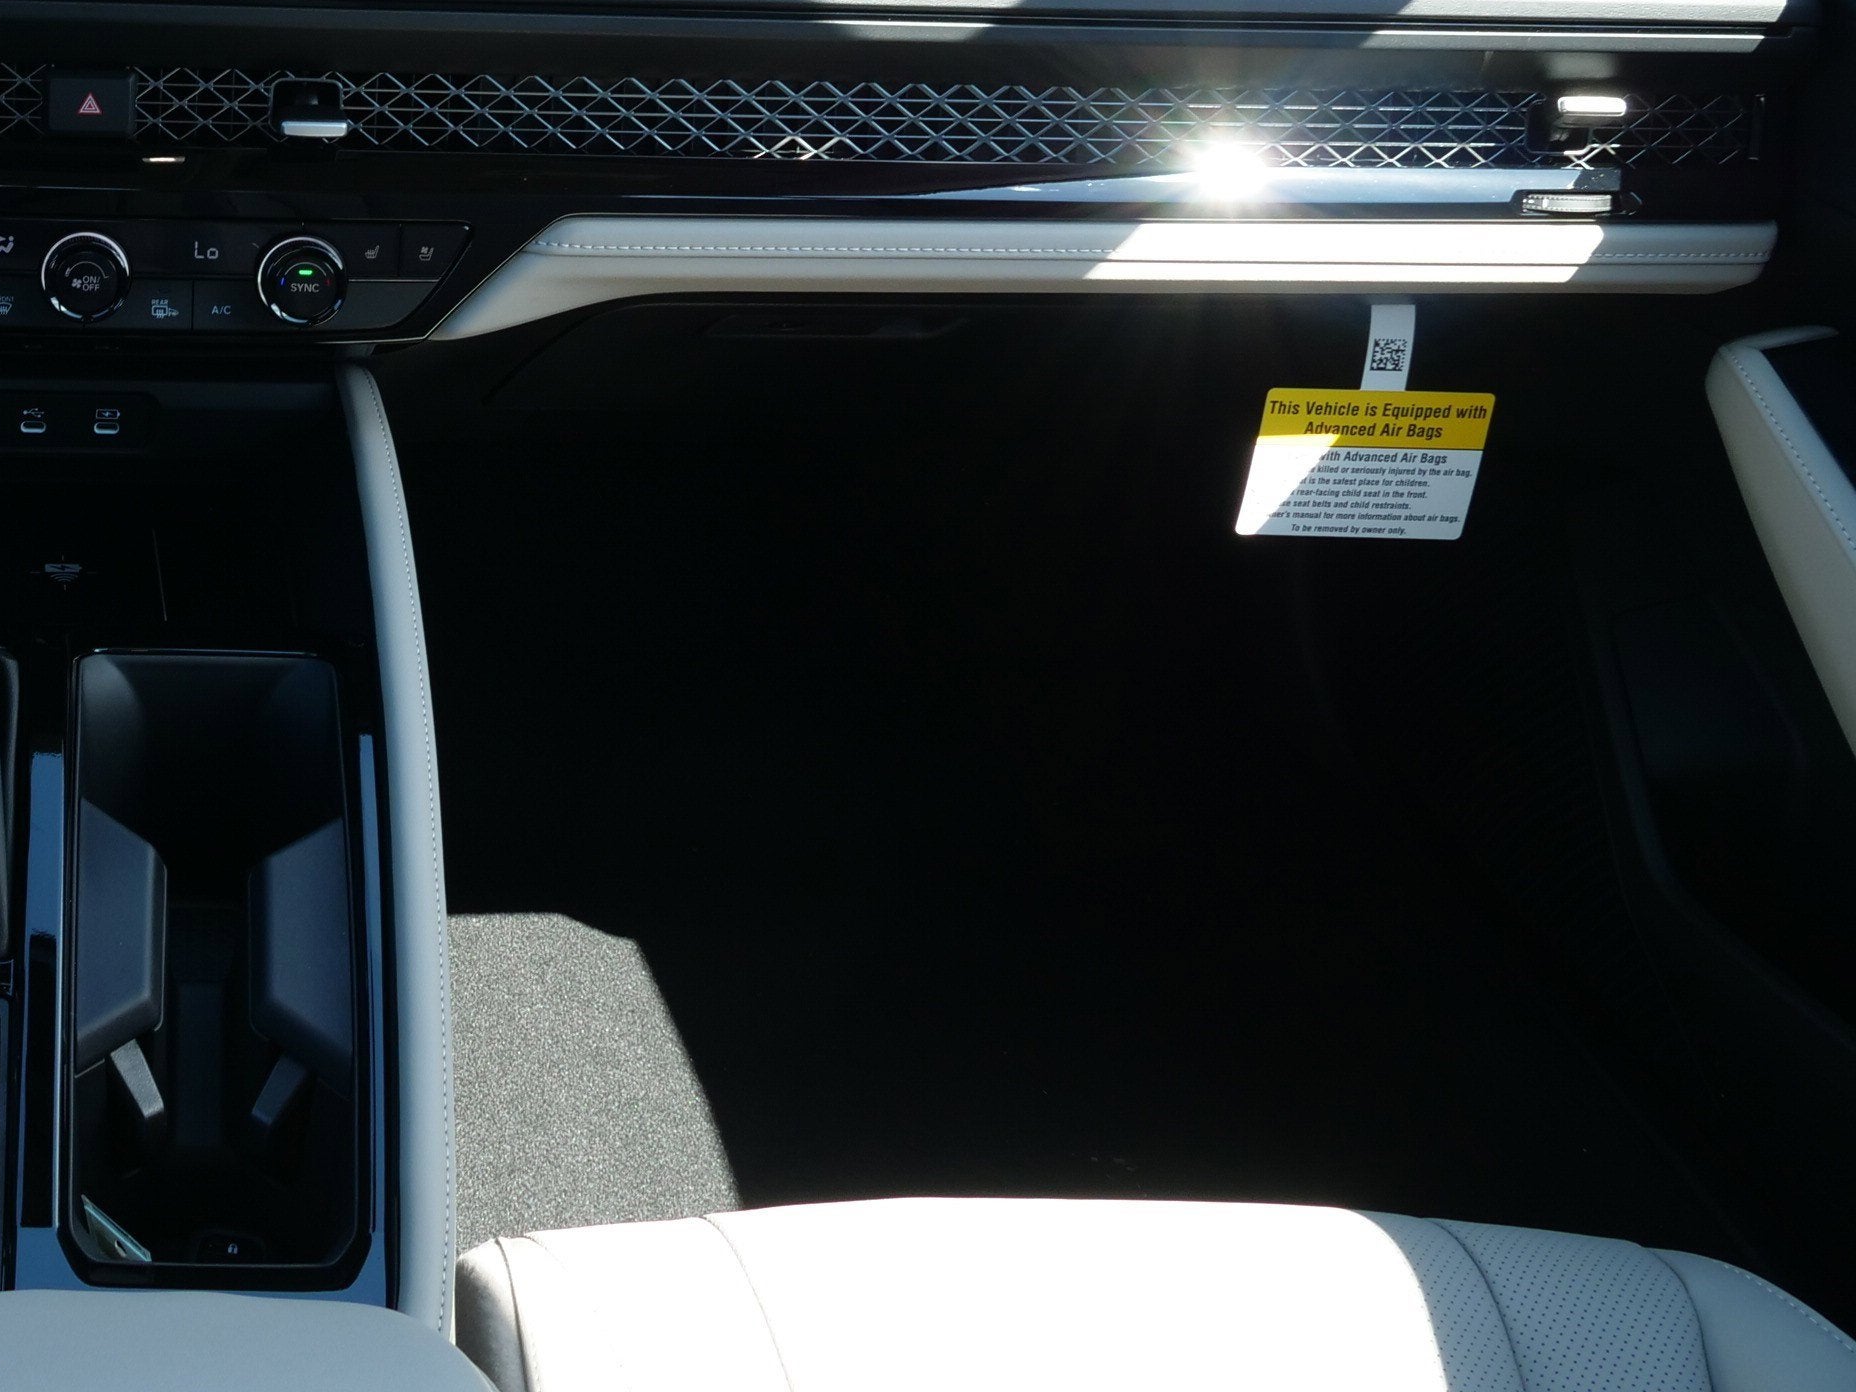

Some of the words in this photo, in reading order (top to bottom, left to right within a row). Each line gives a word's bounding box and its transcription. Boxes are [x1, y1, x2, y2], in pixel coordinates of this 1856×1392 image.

[82, 275, 101, 285] ON/
[82, 283, 100, 292] OFF
[290, 283, 320, 294] SYNC
[211, 305, 232, 315] A/C
[1269, 400, 1300, 415] This
[1305, 401, 1360, 417] Vehicle
[1364, 403, 1377, 417] is
[1381, 403, 1452, 421] Equipped
[1455, 405, 1487, 419] with
[1303, 421, 1375, 437] Advanced
[1380, 423, 1401, 437] Air
[1406, 424, 1443, 441] Bags
[1344, 451, 1397, 463] Advanced
[1400, 452, 1418, 463] Air
[1420, 453, 1448, 465] Bags
[1317, 465, 1340, 474] killed
[1350, 466, 1387, 476] seriously
[1388, 467, 1416, 477] injured
[1417, 467, 1428, 477] by
[1428, 468, 1442, 476] the
[1442, 468, 1454, 477] air
[1455, 469, 1473, 478] bag.
[1309, 477, 1317, 485] is
[1318, 477, 1331, 485] the
[1332, 477, 1357, 486] safest
[1358, 478, 1379, 487] place
[1381, 478, 1394, 487] for
[1395, 479, 1431, 488] children.
[1296, 488, 1341, 498] rear-facing
[1341, 488, 1362, 498] child
[1363, 489, 1380, 498] seat
[1382, 490, 1391, 498] in
[1392, 490, 1405, 499] the
[1406, 490, 1428, 499] front.
[1293, 499, 1311, 508] seat
[1312, 499, 1332, 508] belts
[1333, 500, 1349, 509] and
[1350, 500, 1371, 509] child
[1371, 501, 1412, 510] restraints.
[1292, 511, 1322, 519] manual
[1322, 511, 1334, 520] for
[1335, 512, 1356, 520] more
[1357, 512, 1402, 521] information
[1403, 513, 1427, 522] about
[1427, 514, 1439, 522] air
[1439, 514, 1461, 524] bags.
[1290, 523, 1300, 532] To
[1301, 524, 1312, 532] be
[1313, 524, 1349, 533] removed
[1350, 524, 1361, 534] by
[1361, 526, 1385, 534] owner
[1387, 526, 1406, 536] only.
